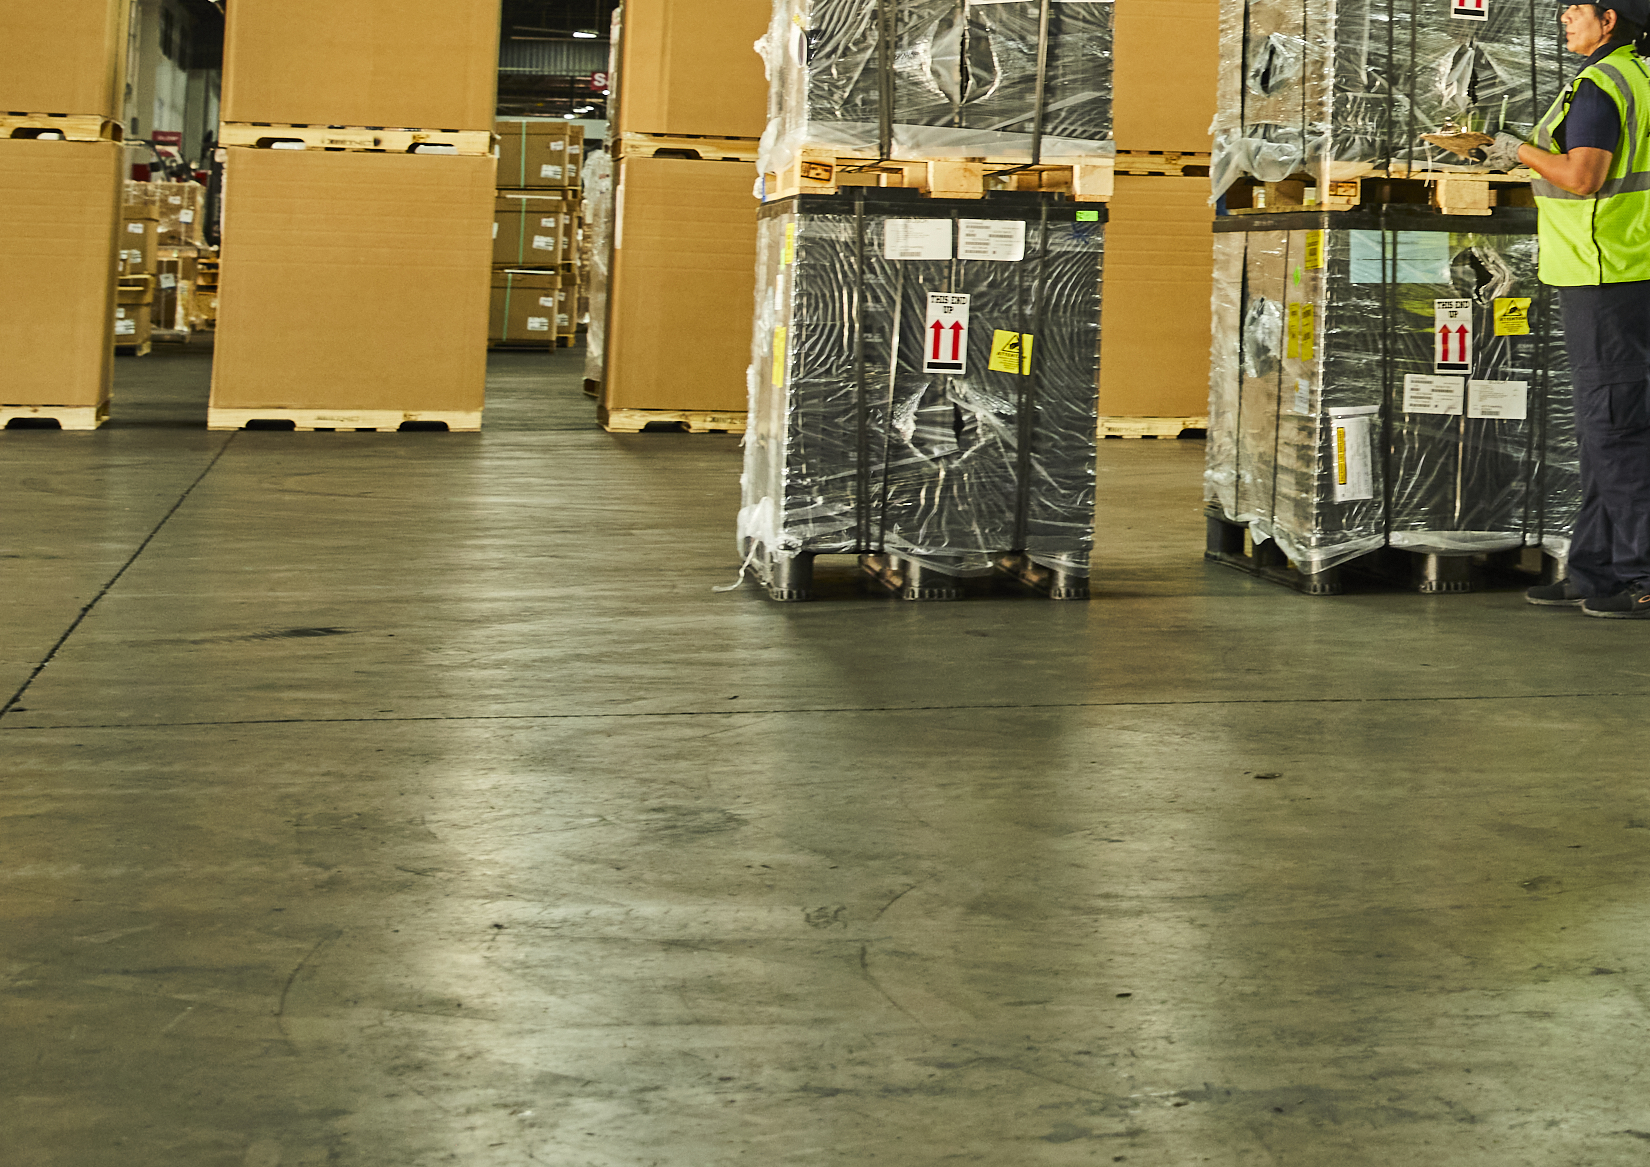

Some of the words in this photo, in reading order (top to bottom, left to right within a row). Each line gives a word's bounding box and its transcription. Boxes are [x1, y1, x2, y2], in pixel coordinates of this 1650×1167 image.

[930, 294, 949, 304] THIS
[951, 296, 968, 305] END
[1437, 301, 1453, 309] THIS
[1455, 301, 1470, 309] END
[943, 306, 954, 314] UP
[1448, 310, 1459, 318] UP
